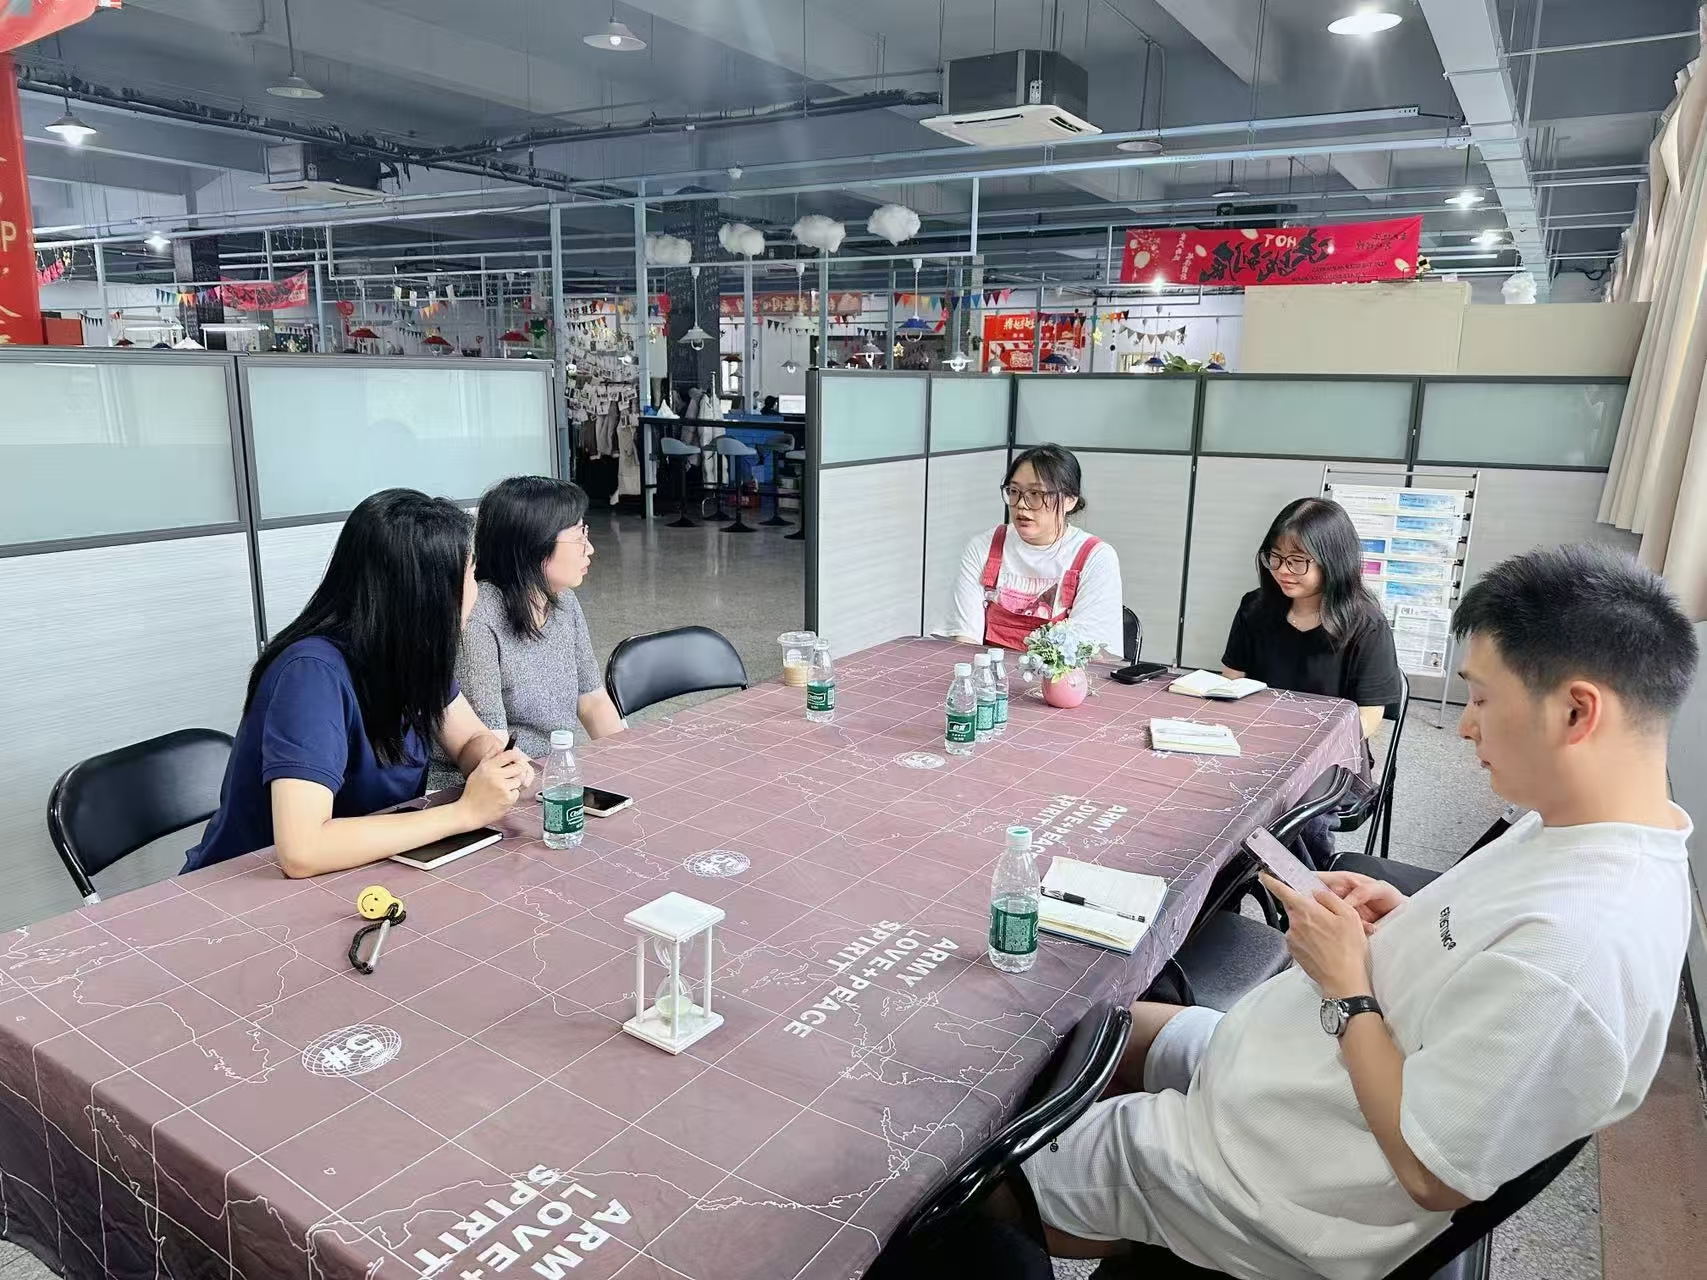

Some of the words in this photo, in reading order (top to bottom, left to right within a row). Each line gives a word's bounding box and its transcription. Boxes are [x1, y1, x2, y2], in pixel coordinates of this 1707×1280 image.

[1087, 804, 1128, 834] ARMY
[827, 919, 903, 972] SPIRIT
[896, 937, 960, 988] ARMY
[783, 929, 931, 1039] LOVE+PEACE
[413, 1164, 561, 1276] SPIRIT
